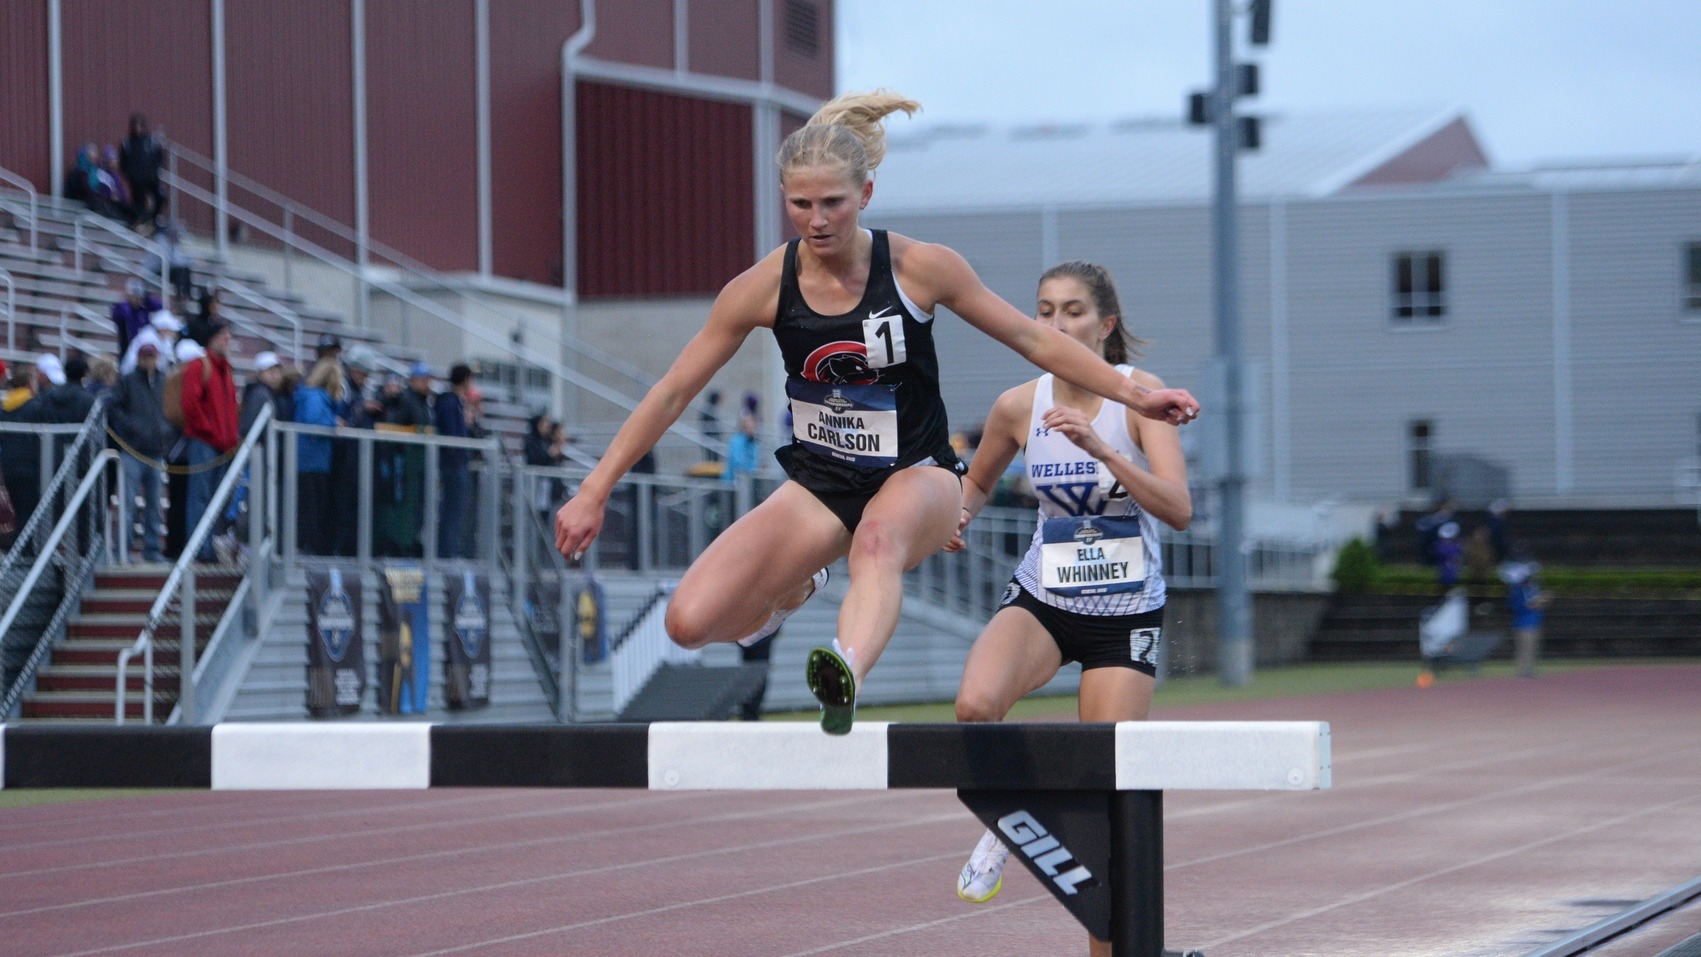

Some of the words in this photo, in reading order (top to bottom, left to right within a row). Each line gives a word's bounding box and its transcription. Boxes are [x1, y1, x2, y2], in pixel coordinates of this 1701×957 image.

[875, 321, 894, 364] 1
[818, 411, 865, 429] ANNIKA
[807, 423, 880, 452] CARLSON
[1031, 461, 1098, 478] WELLES
[1077, 547, 1105, 561] ELLA
[1057, 562, 1129, 583] WHINNEY
[998, 810, 1092, 895] GILL
